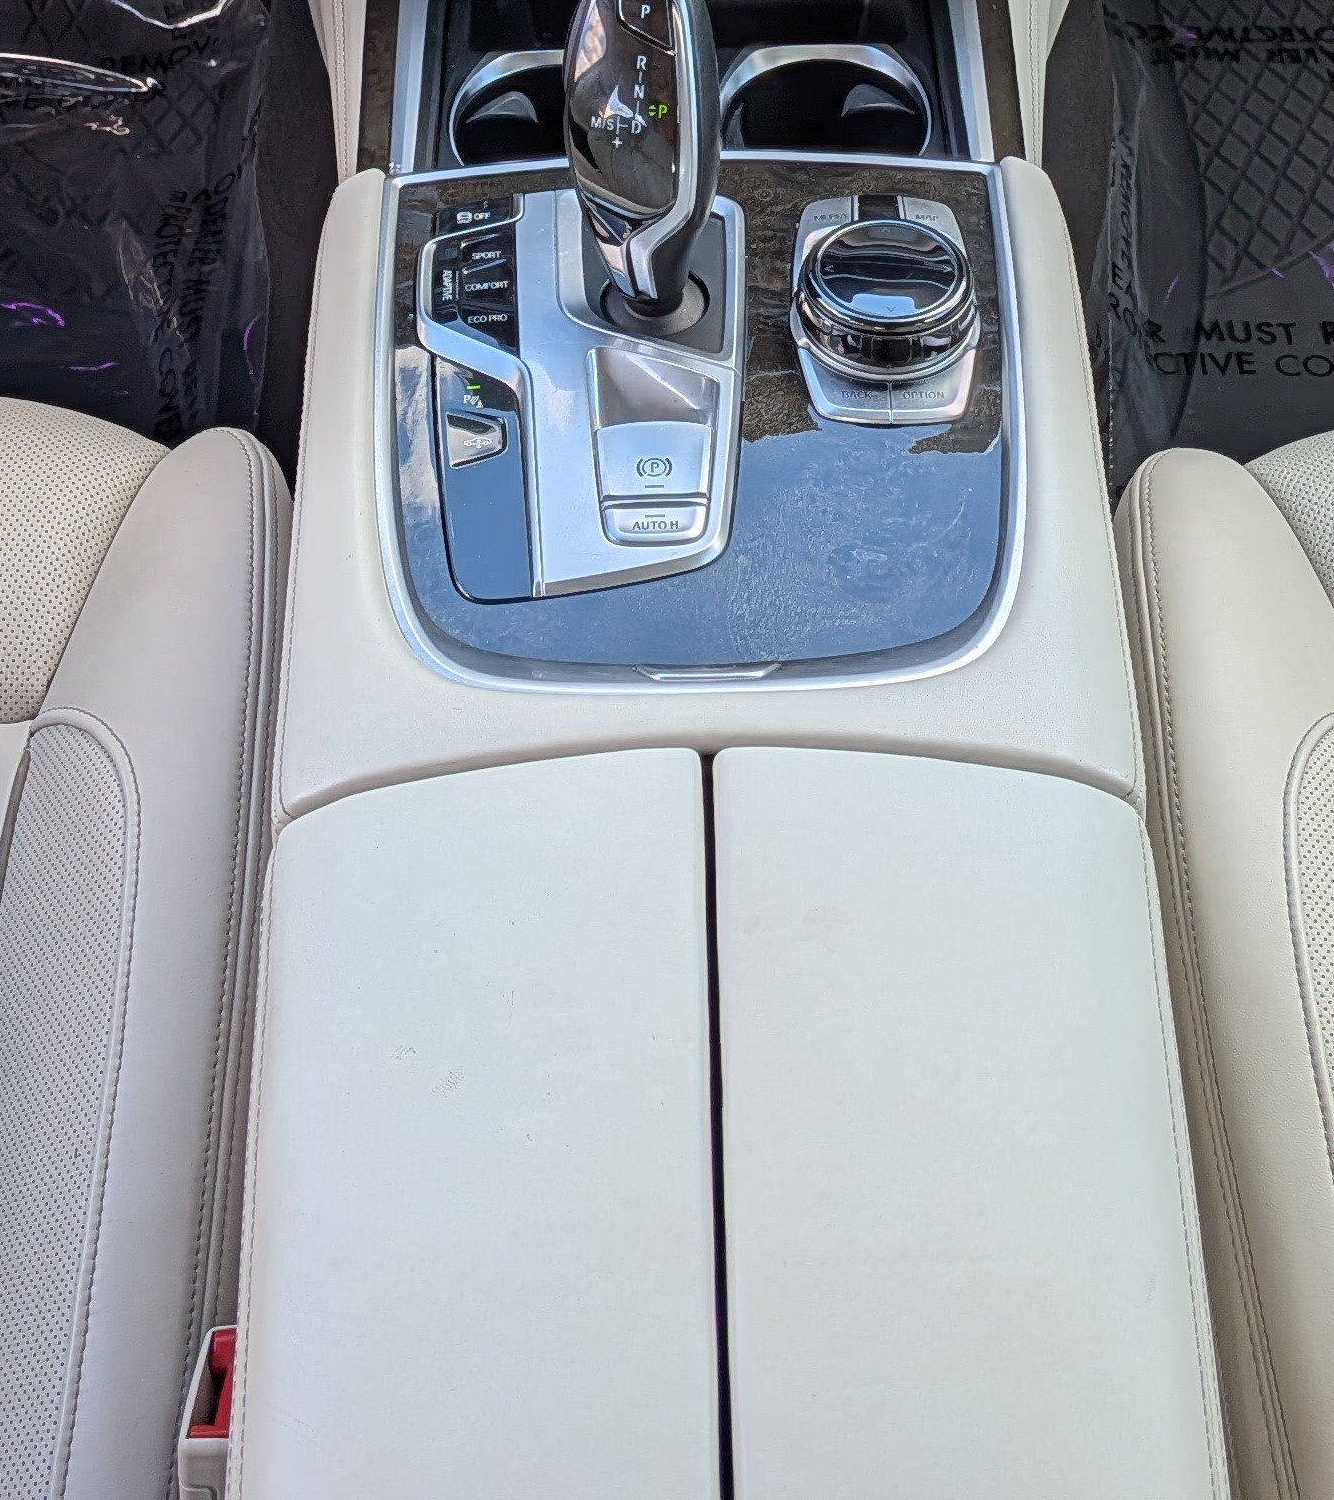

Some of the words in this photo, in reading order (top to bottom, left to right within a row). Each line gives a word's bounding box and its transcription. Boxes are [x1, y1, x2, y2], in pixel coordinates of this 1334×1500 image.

[640, 4, 651, 19] P
[636, 55, 647, 70] R
[633, 87, 645, 101] N
[657, 104, 668, 119] P
[473, 211, 491, 221] OFF
[915, 213, 940, 221] MAP
[471, 250, 502, 260] SPORT
[441, 269, 453, 301] ADAPTIVE
[464, 280, 509, 292] COMFORT
[467, 315, 487, 324] ECO
[488, 313, 508, 323] PRO
[1195, 319, 1297, 347] MUST
[840, 389, 872, 400] BACK
[901, 390, 945, 400] OPTION
[632, 520, 668, 531] AUTO
[669, 520, 679, 530] H
